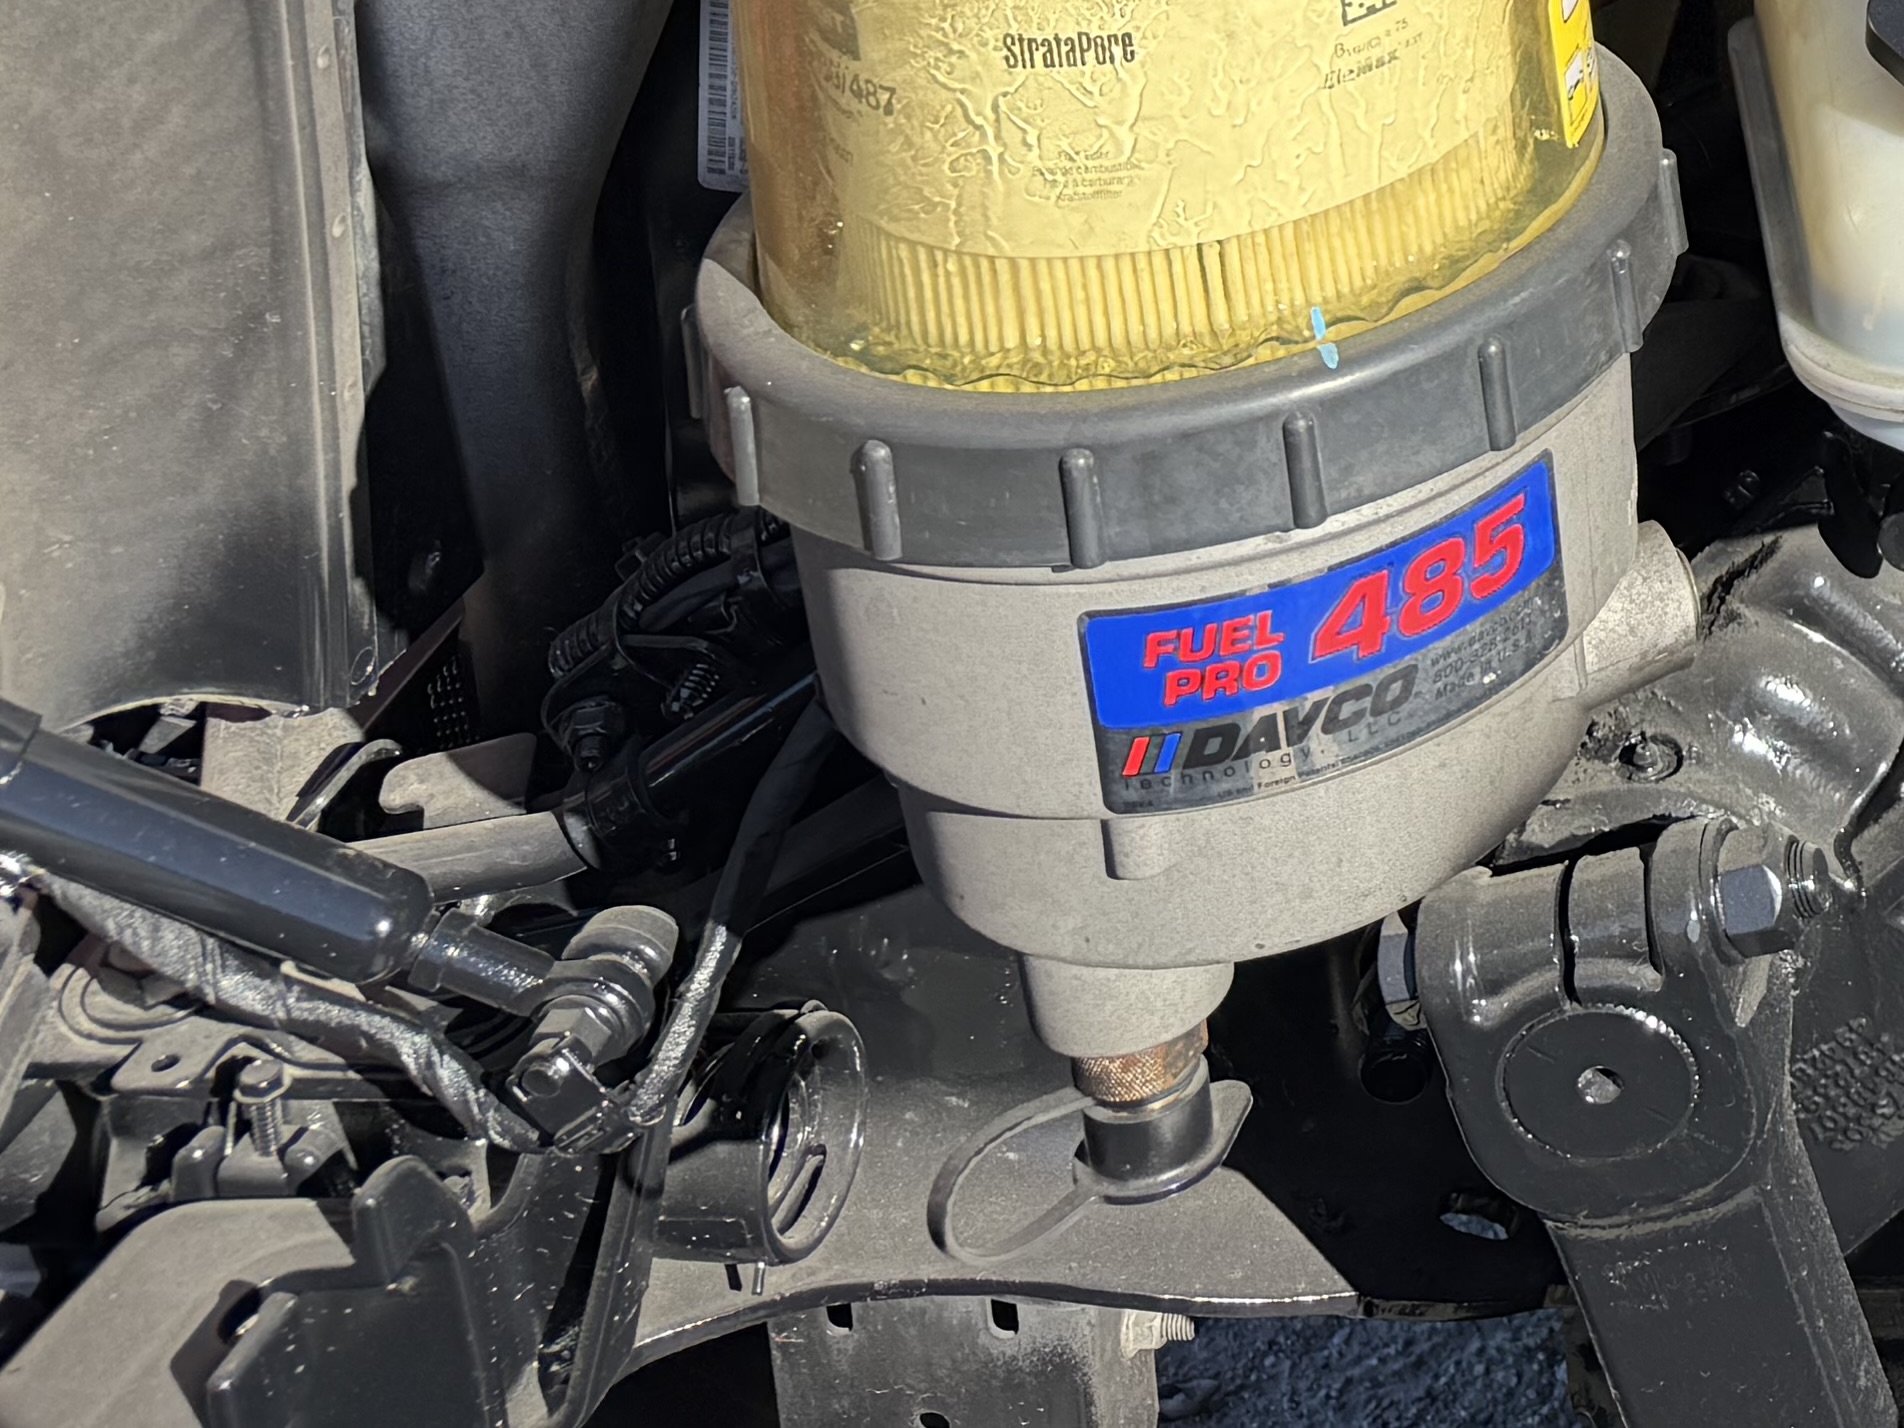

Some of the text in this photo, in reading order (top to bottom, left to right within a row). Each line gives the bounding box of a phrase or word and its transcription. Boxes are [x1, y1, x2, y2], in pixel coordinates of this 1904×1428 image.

[1000, 25, 1138, 74] StrataPore
[1309, 491, 1528, 665] 485
[1143, 610, 1285, 669] FUEL
[1163, 650, 1283, 709] PRO
[1348, 710, 1403, 745] LLC
